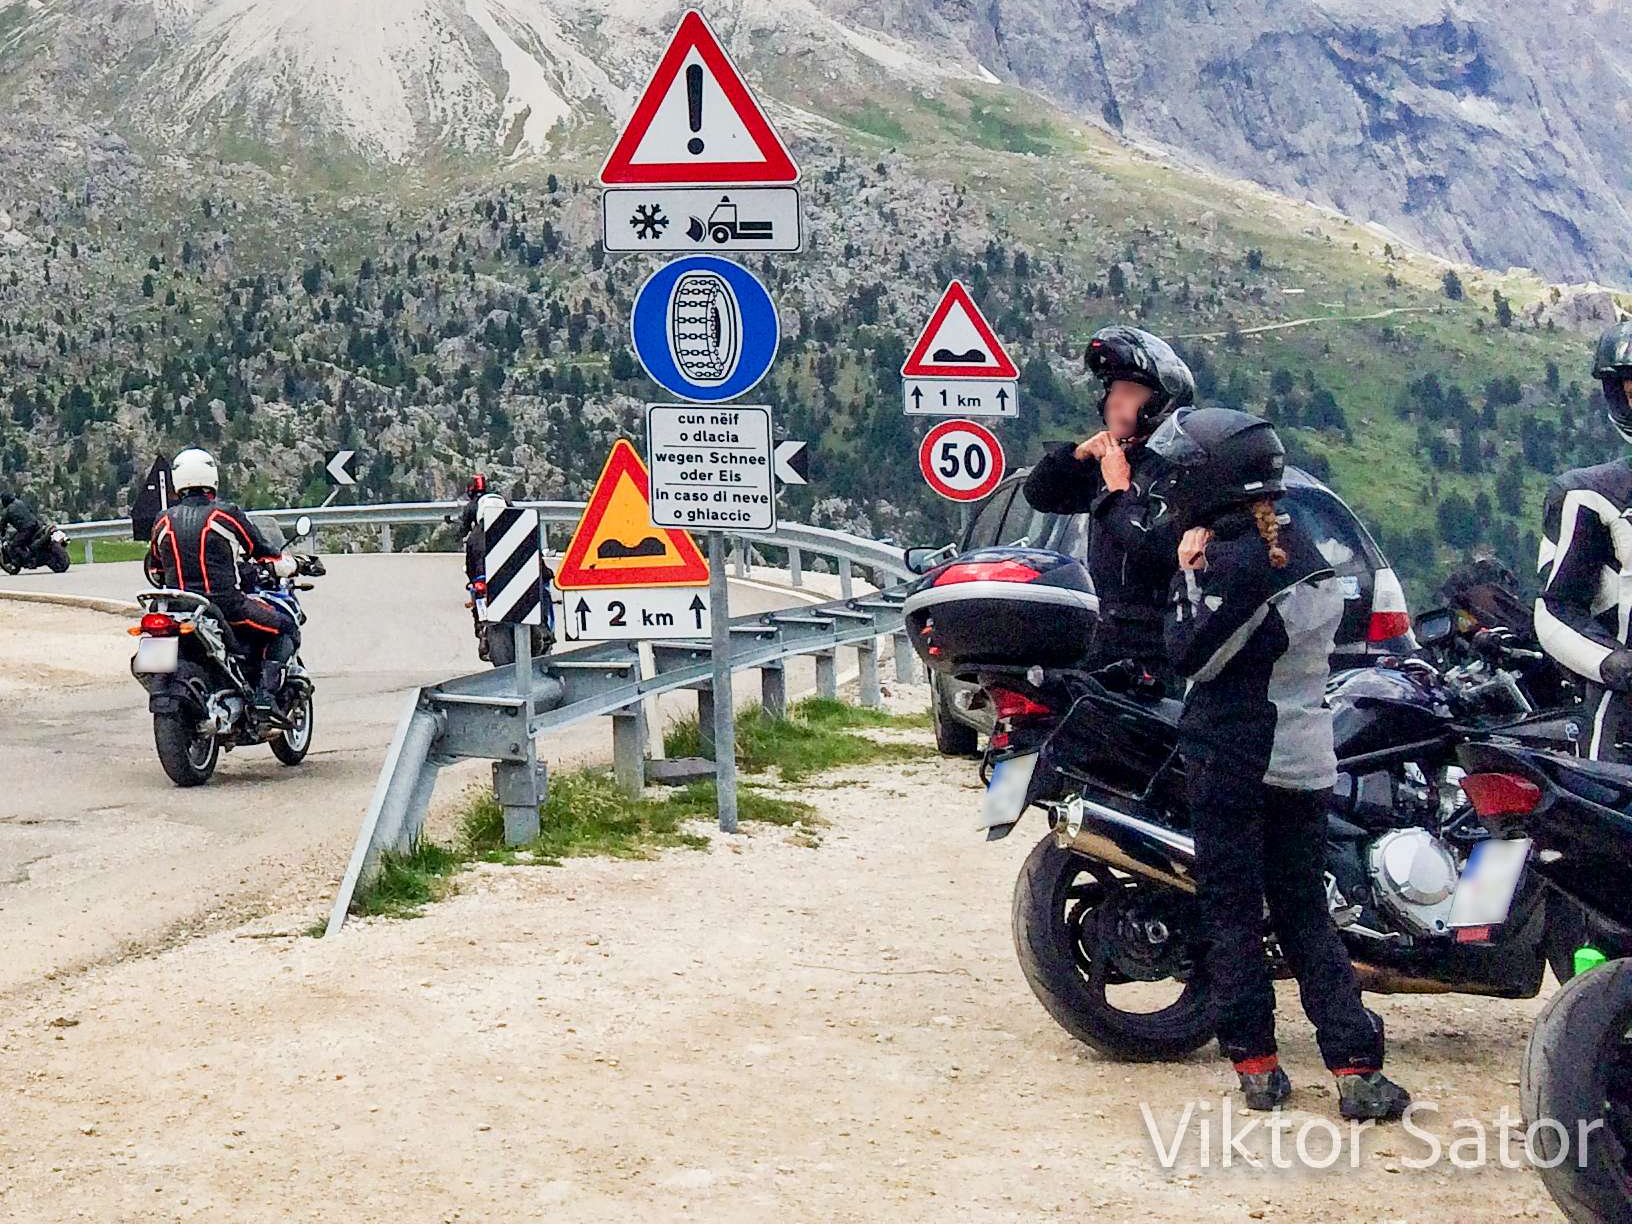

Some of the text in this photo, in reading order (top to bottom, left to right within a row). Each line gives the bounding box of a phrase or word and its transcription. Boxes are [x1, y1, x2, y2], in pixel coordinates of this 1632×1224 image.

[939, 389, 981, 407] 1 km
[678, 412, 739, 425] cun nëif
[679, 430, 739, 443] o dlacia
[655, 452, 766, 465] wegen Schnee
[939, 443, 986, 479] 50
[680, 469, 742, 482] oder Eis
[655, 488, 769, 504] in caso di neve
[673, 508, 751, 522] o ghiaccio
[607, 600, 674, 627] 2 km
